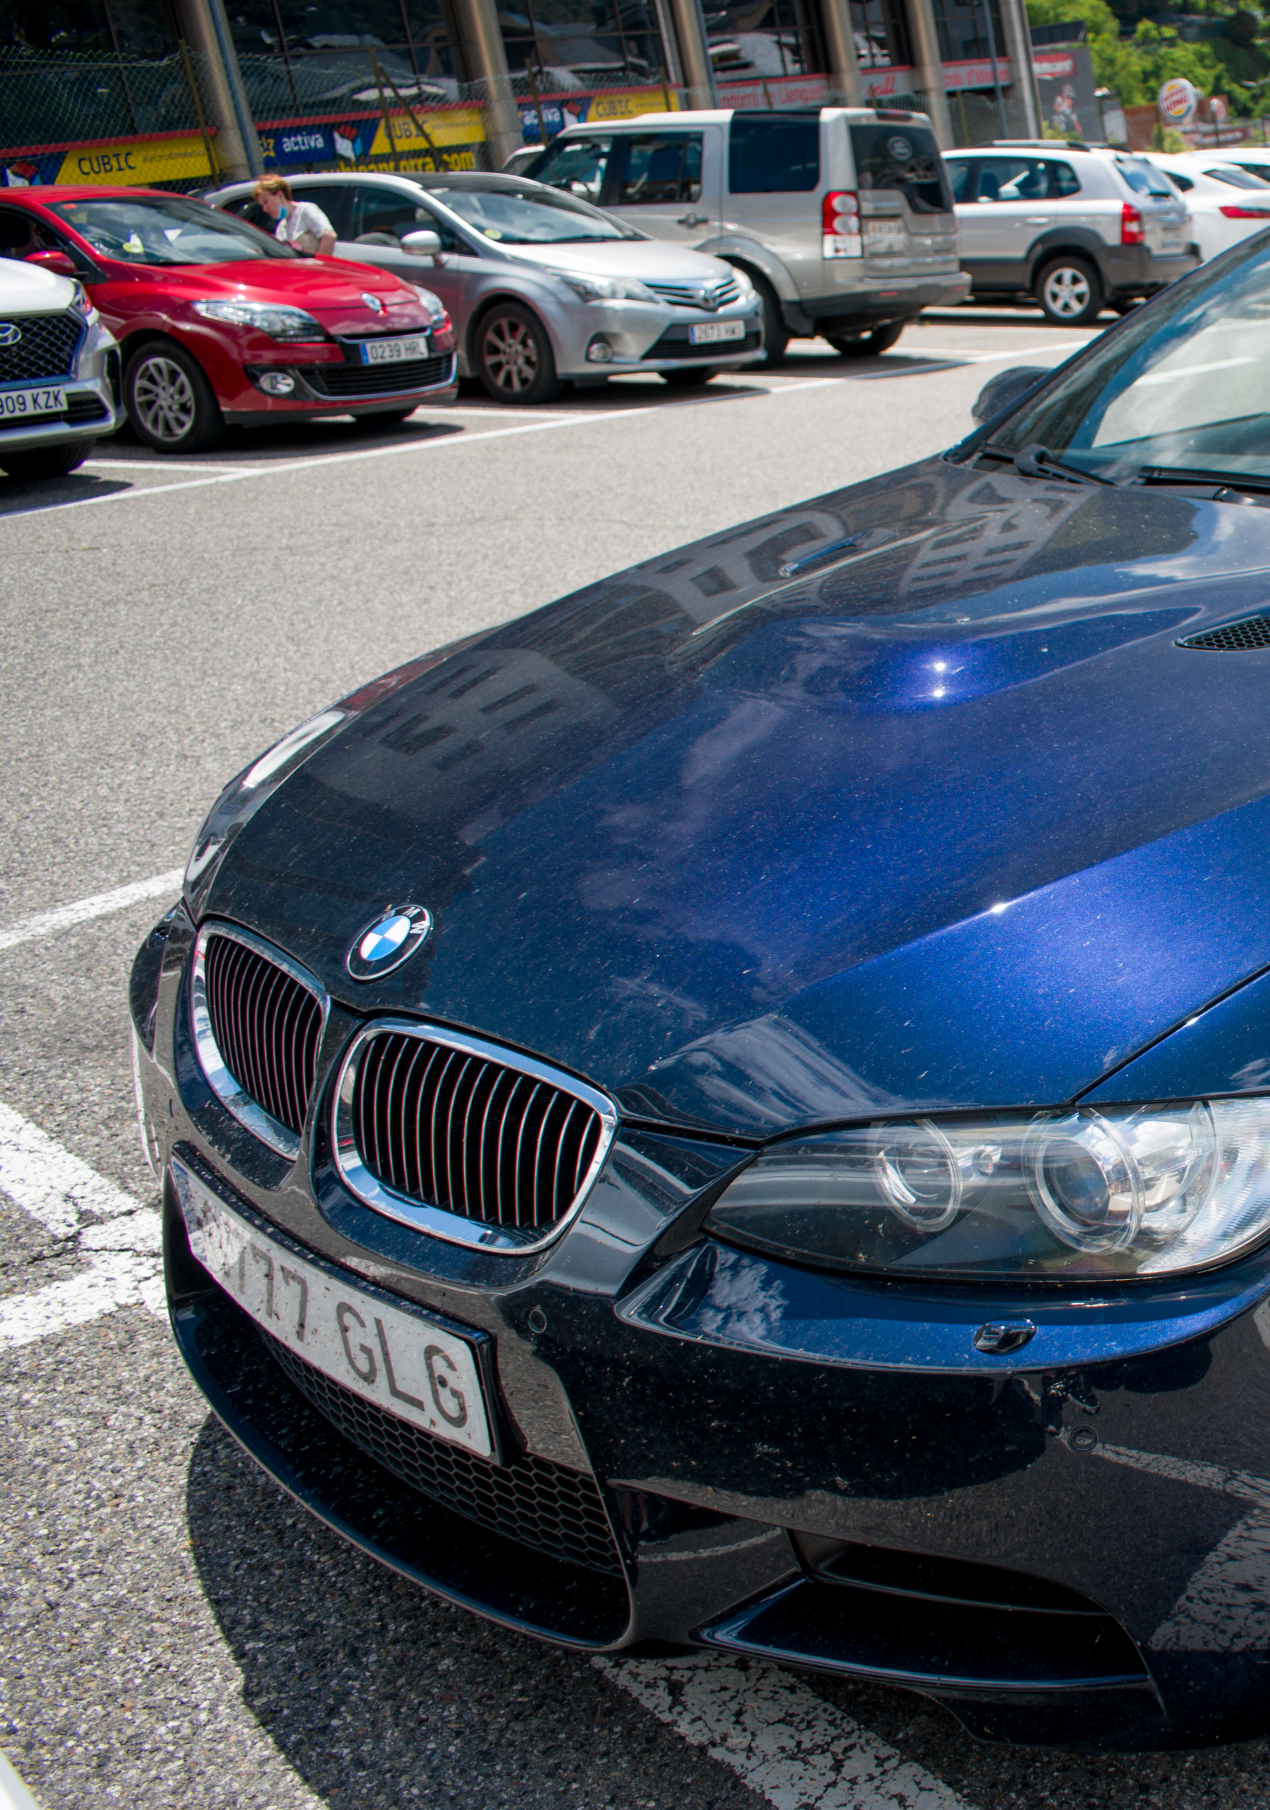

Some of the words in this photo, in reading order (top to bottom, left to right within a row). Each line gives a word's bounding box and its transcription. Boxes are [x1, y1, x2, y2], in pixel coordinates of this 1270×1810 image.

[595, 99, 633, 117] CUBIC
[281, 131, 325, 153] activa
[77, 152, 136, 176] CUBIC
[369, 342, 402, 360] 0239
[31, 389, 63, 411] KZK
